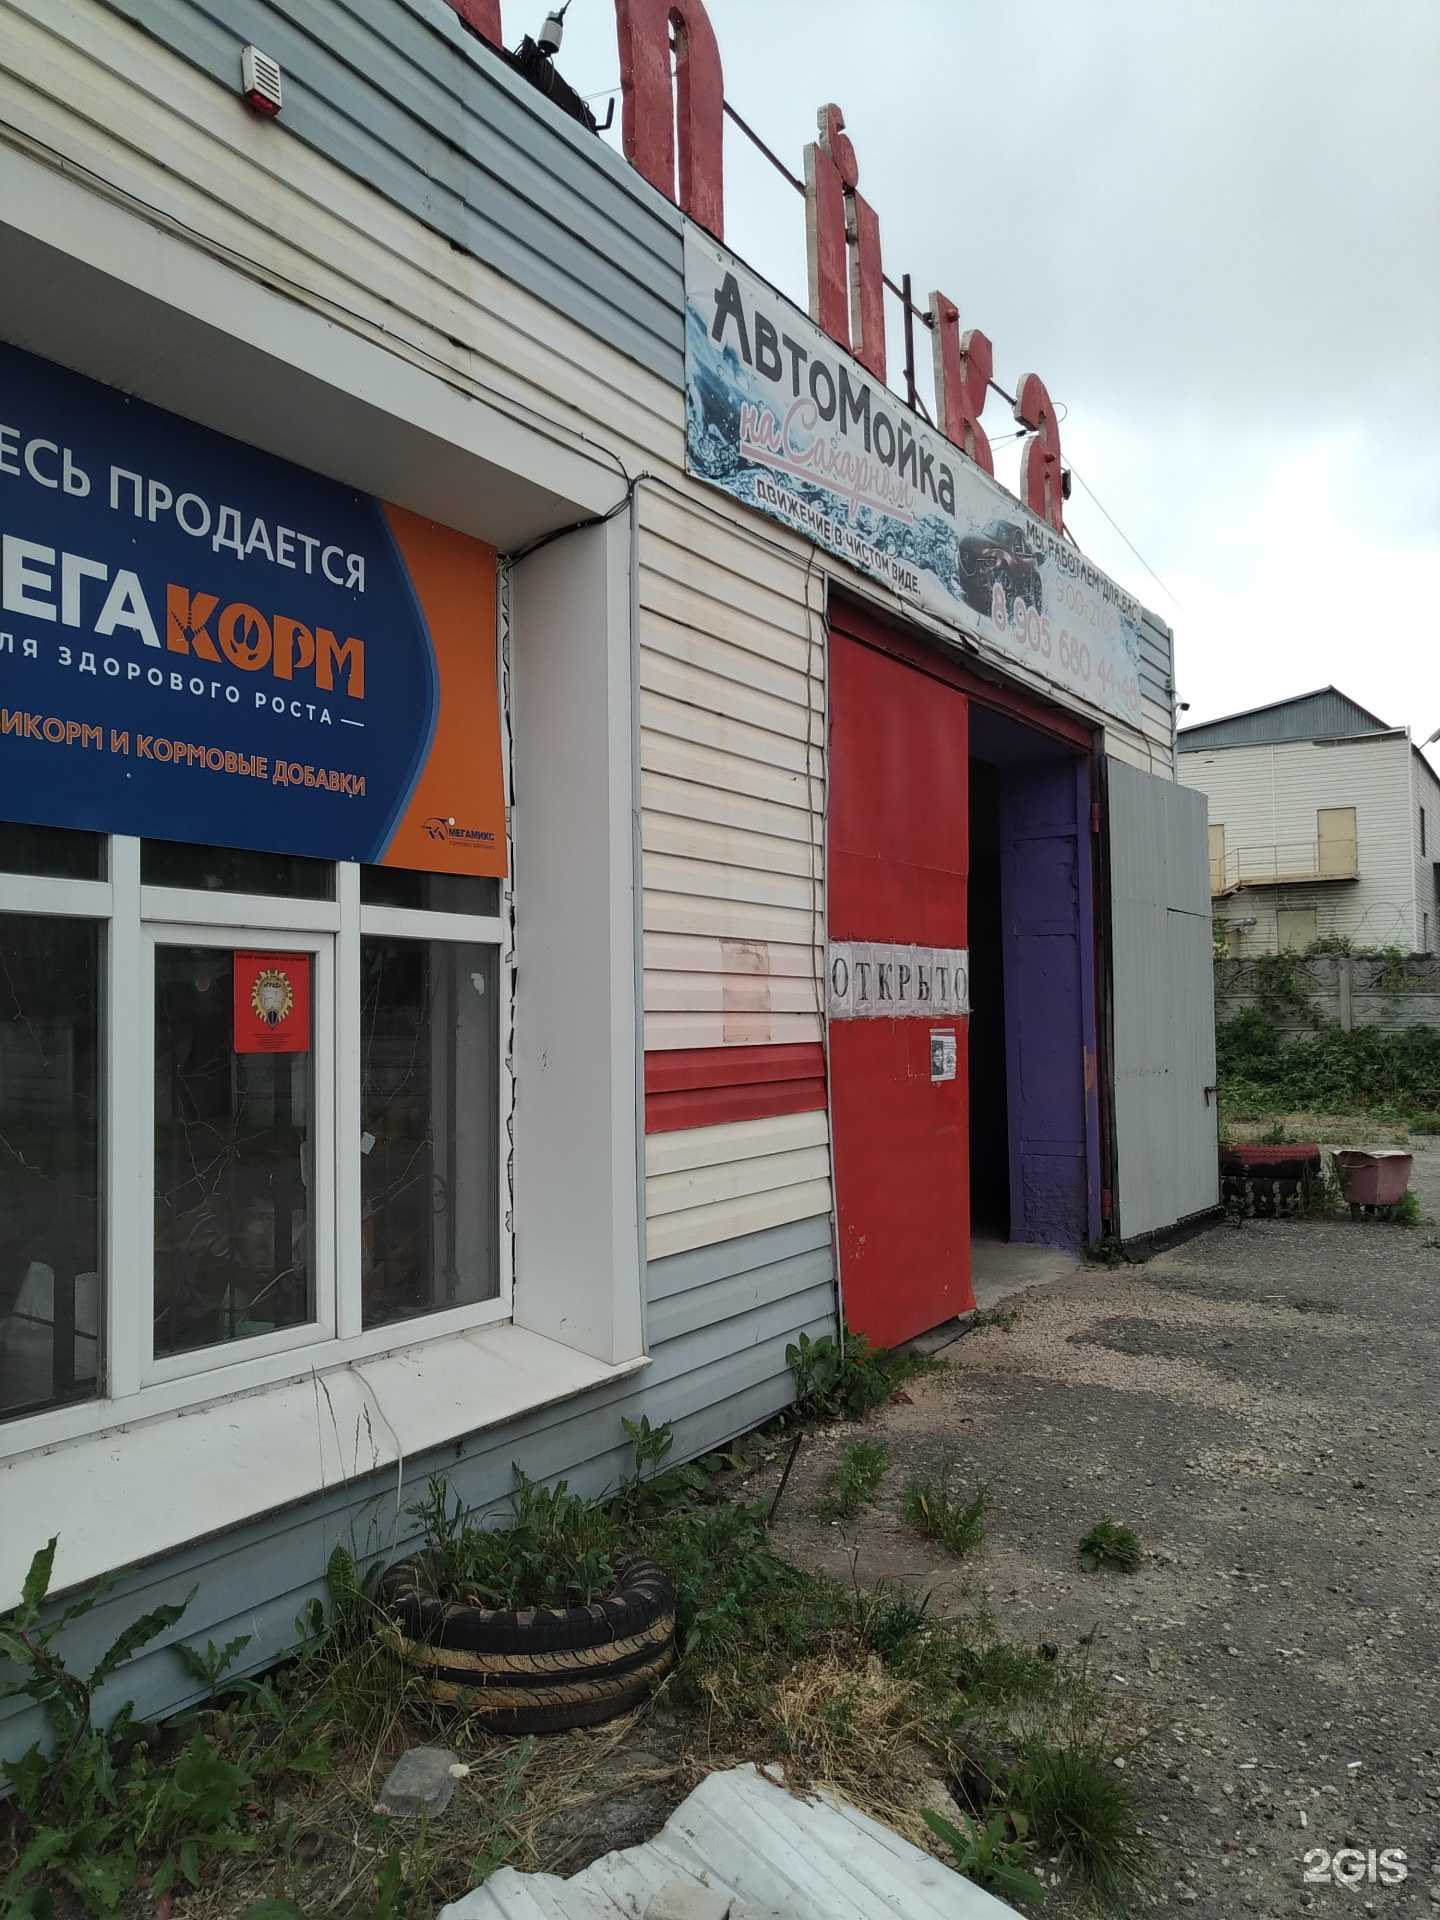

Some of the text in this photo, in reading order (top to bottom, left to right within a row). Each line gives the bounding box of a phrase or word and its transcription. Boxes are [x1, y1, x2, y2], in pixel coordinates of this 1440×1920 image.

[110, 465, 366, 593] ПРОДАЕТСЯ
[756, 479, 832, 541] ДВИЖЕНИЕ
[833, 527, 844, 547] В
[845, 534, 891, 575] ЧИСТОМ
[1025, 519, 1044, 553] МЫ
[1047, 535, 1101, 594] РАБОТАЕМ
[992, 583, 1008, 632] 8
[1014, 597, 1052, 659] 905
[1059, 630, 1090, 681] 680
[57, 645, 241, 704] ЗДОРОВОГО
[255, 692, 334, 726] РОСТА
[0, 708, 366, 798] ИКОРМ И КОРМОВЫЕ ДОБАВКИ
[448, 827, 496, 842] МЕГАМИКС
[831, 957, 968, 1001] ОТКРЫТО
